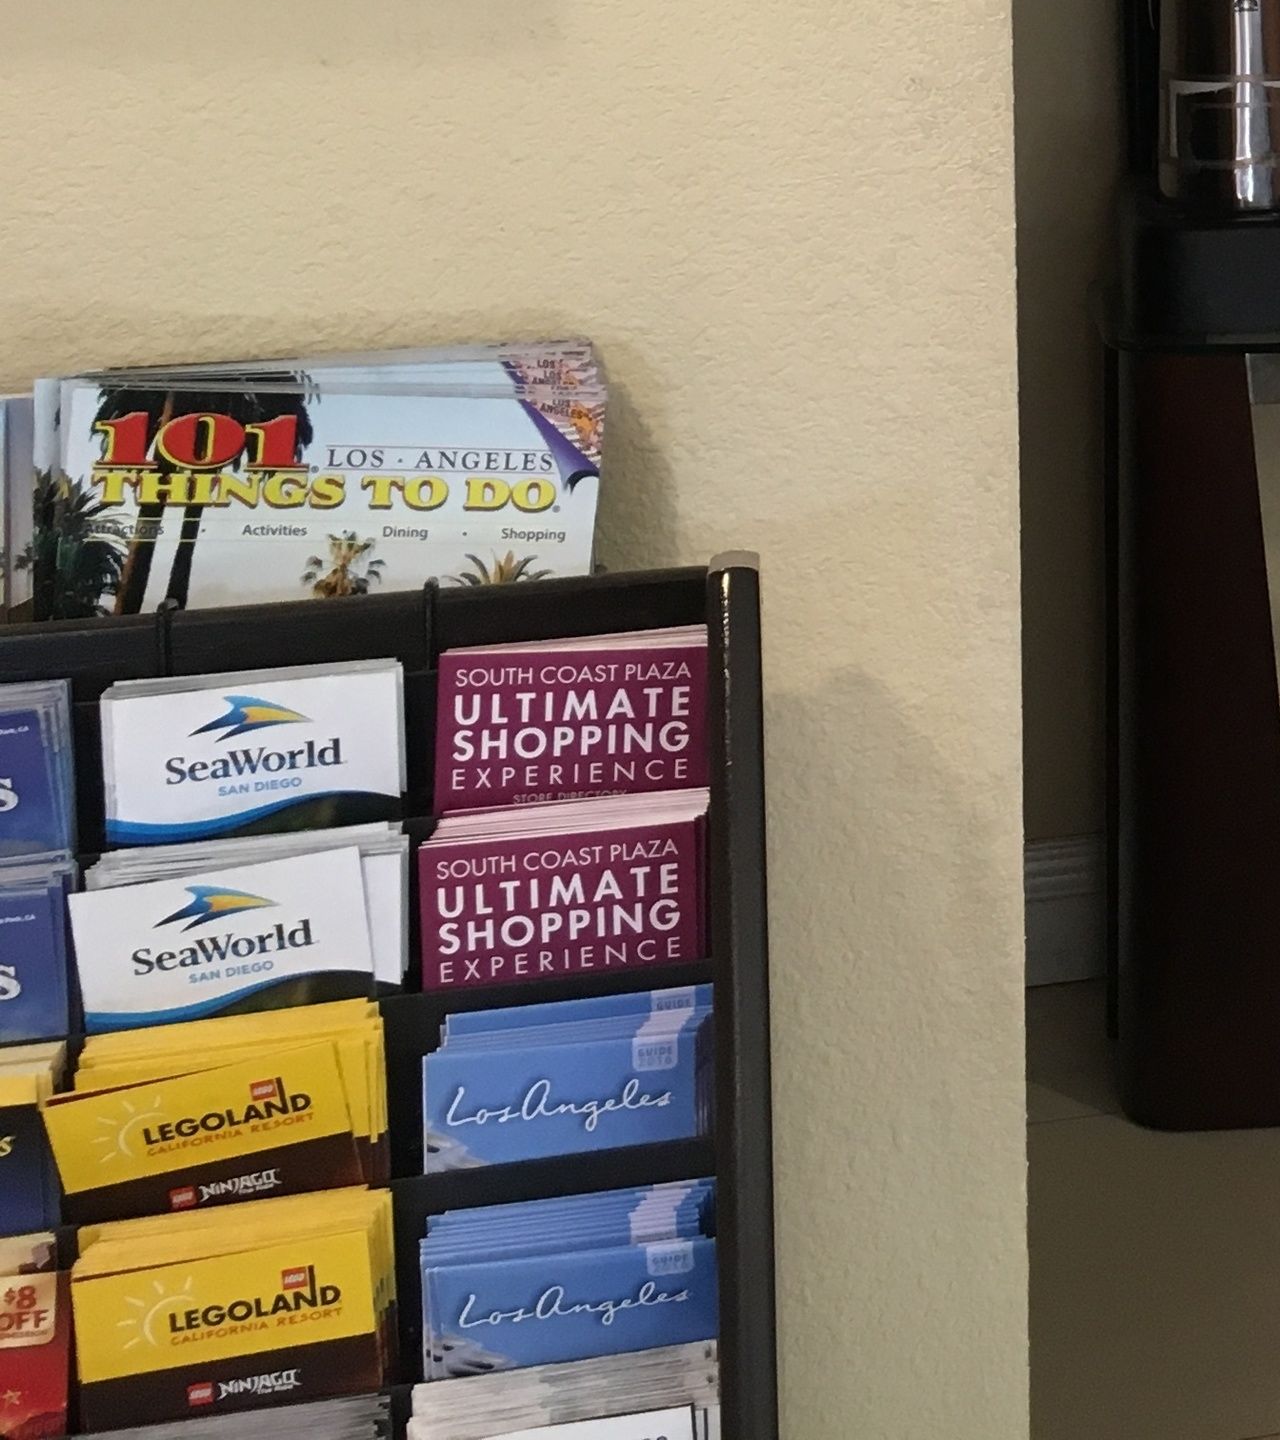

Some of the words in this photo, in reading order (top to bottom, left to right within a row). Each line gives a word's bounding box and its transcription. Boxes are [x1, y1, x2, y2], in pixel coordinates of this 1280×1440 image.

[93, 411, 309, 472] 101
[328, 448, 384, 468] LOS
[415, 450, 552, 471] ANGELES
[92, 469, 346, 510] THINGS
[361, 474, 449, 511] TO
[463, 476, 557, 513] DO
[242, 523, 308, 536] Activities
[383, 525, 429, 540] Dining
[501, 528, 566, 543] Shopping
[455, 667, 533, 687] SOUTH
[540, 664, 619, 685] COAST
[624, 661, 692, 681] PLAZA
[454, 686, 691, 726] ULTIMATE
[452, 720, 690, 761] SHOPPING
[165, 737, 344, 785] SeaWorld
[451, 758, 688, 790] EXPERIENCE
[218, 785, 250, 797] SAN
[254, 776, 302, 792] DIEGO
[436, 855, 517, 880] SOUTH
[523, 845, 603, 871] COAST
[609, 838, 679, 862] PLAZA
[437, 862, 679, 919] ULTIMATE
[131, 918, 314, 976] SeaWorld
[438, 899, 681, 955] SHOPPING
[188, 969, 221, 984] SAN
[225, 960, 274, 978] DIEGO
[439, 936, 681, 984] EXPERIENCE
[143, 1076, 312, 1145] LEGOLAND
[146, 1128, 244, 1157] CALIFORNIA
[250, 1111, 315, 1134] RESORT
[198, 1168, 283, 1202] NINJAGO
[4, 1285, 37, 1310] $8
[168, 1264, 342, 1333] LEGOLAND
[0, 1308, 50, 1331] OFF
[170, 1321, 270, 1347] CALIFORNIA
[276, 1307, 343, 1328] RESORT
[216, 1368, 303, 1402] NINJAGO
